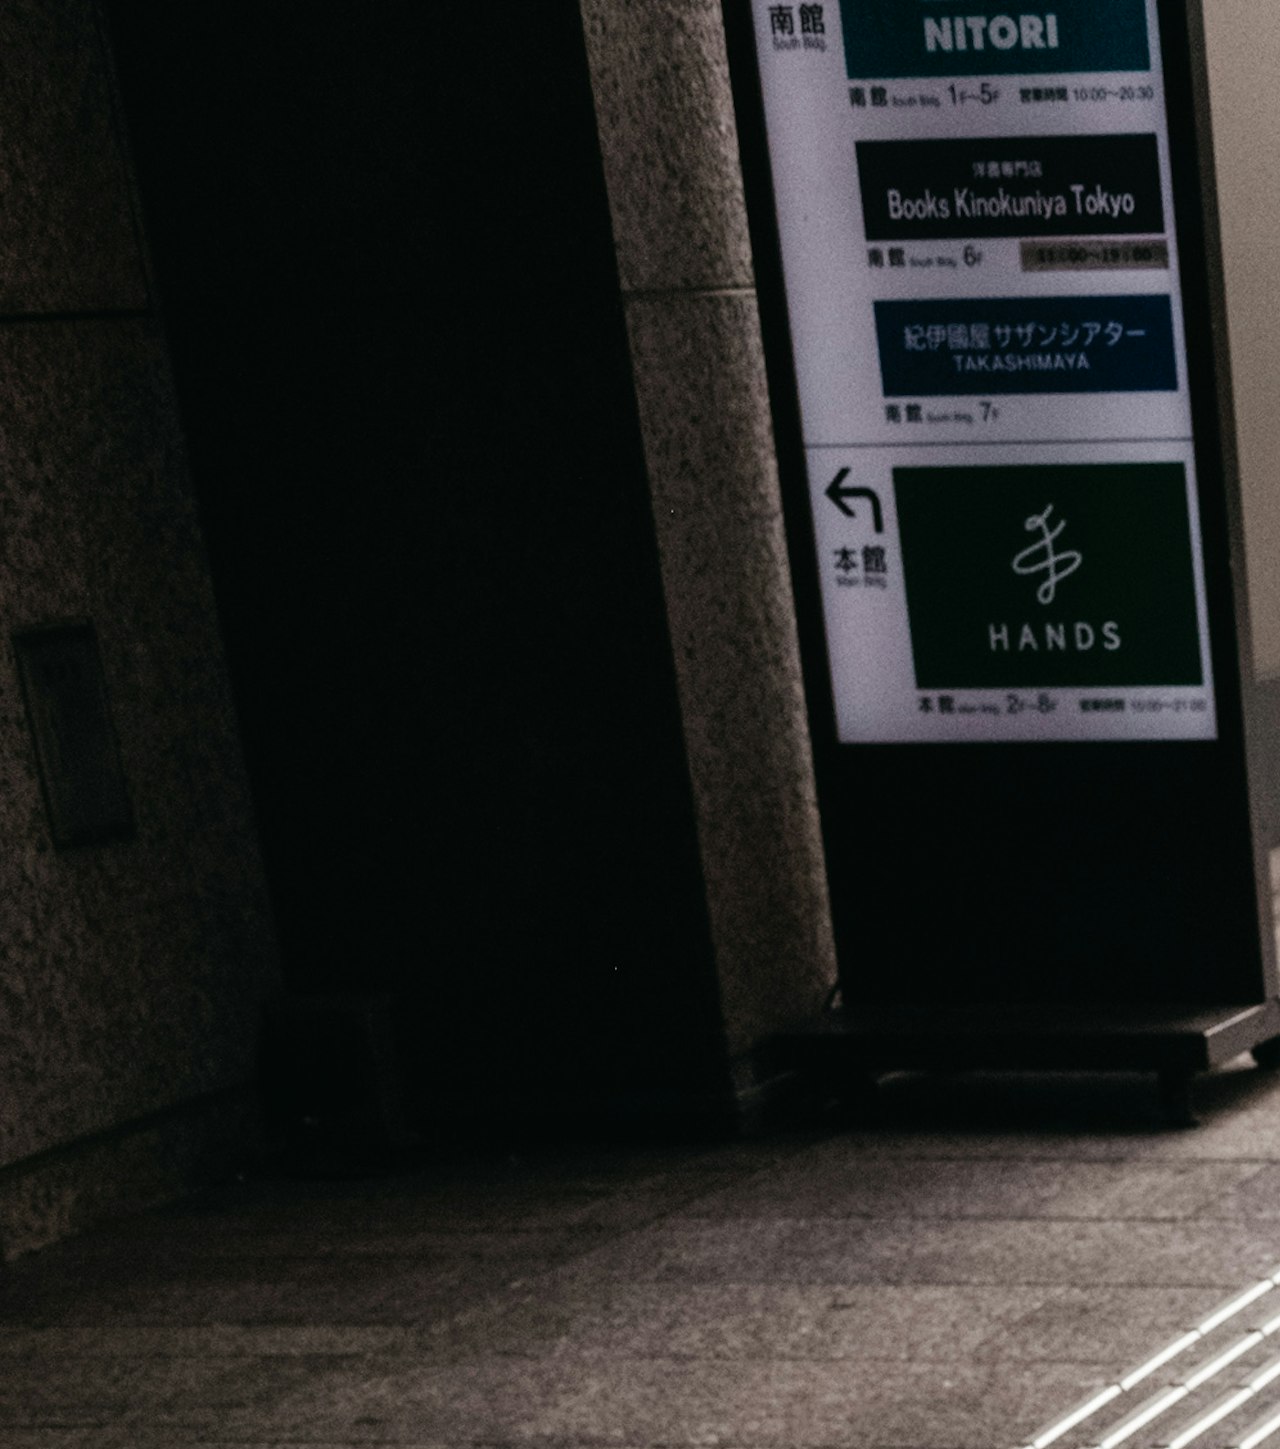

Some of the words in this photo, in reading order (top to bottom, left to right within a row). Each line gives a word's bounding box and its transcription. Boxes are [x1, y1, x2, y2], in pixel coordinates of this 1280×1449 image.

[768, 4, 825, 36] 南館
[923, 14, 1059, 52] NITORI
[887, 189, 950, 219] Books
[953, 187, 1067, 219] Kinokuniya
[1070, 183, 1136, 218] Tokyo
[952, 352, 1092, 372] TAKASHIMAYA
[833, 545, 888, 575] 本館
[988, 620, 1122, 652] HANDS
